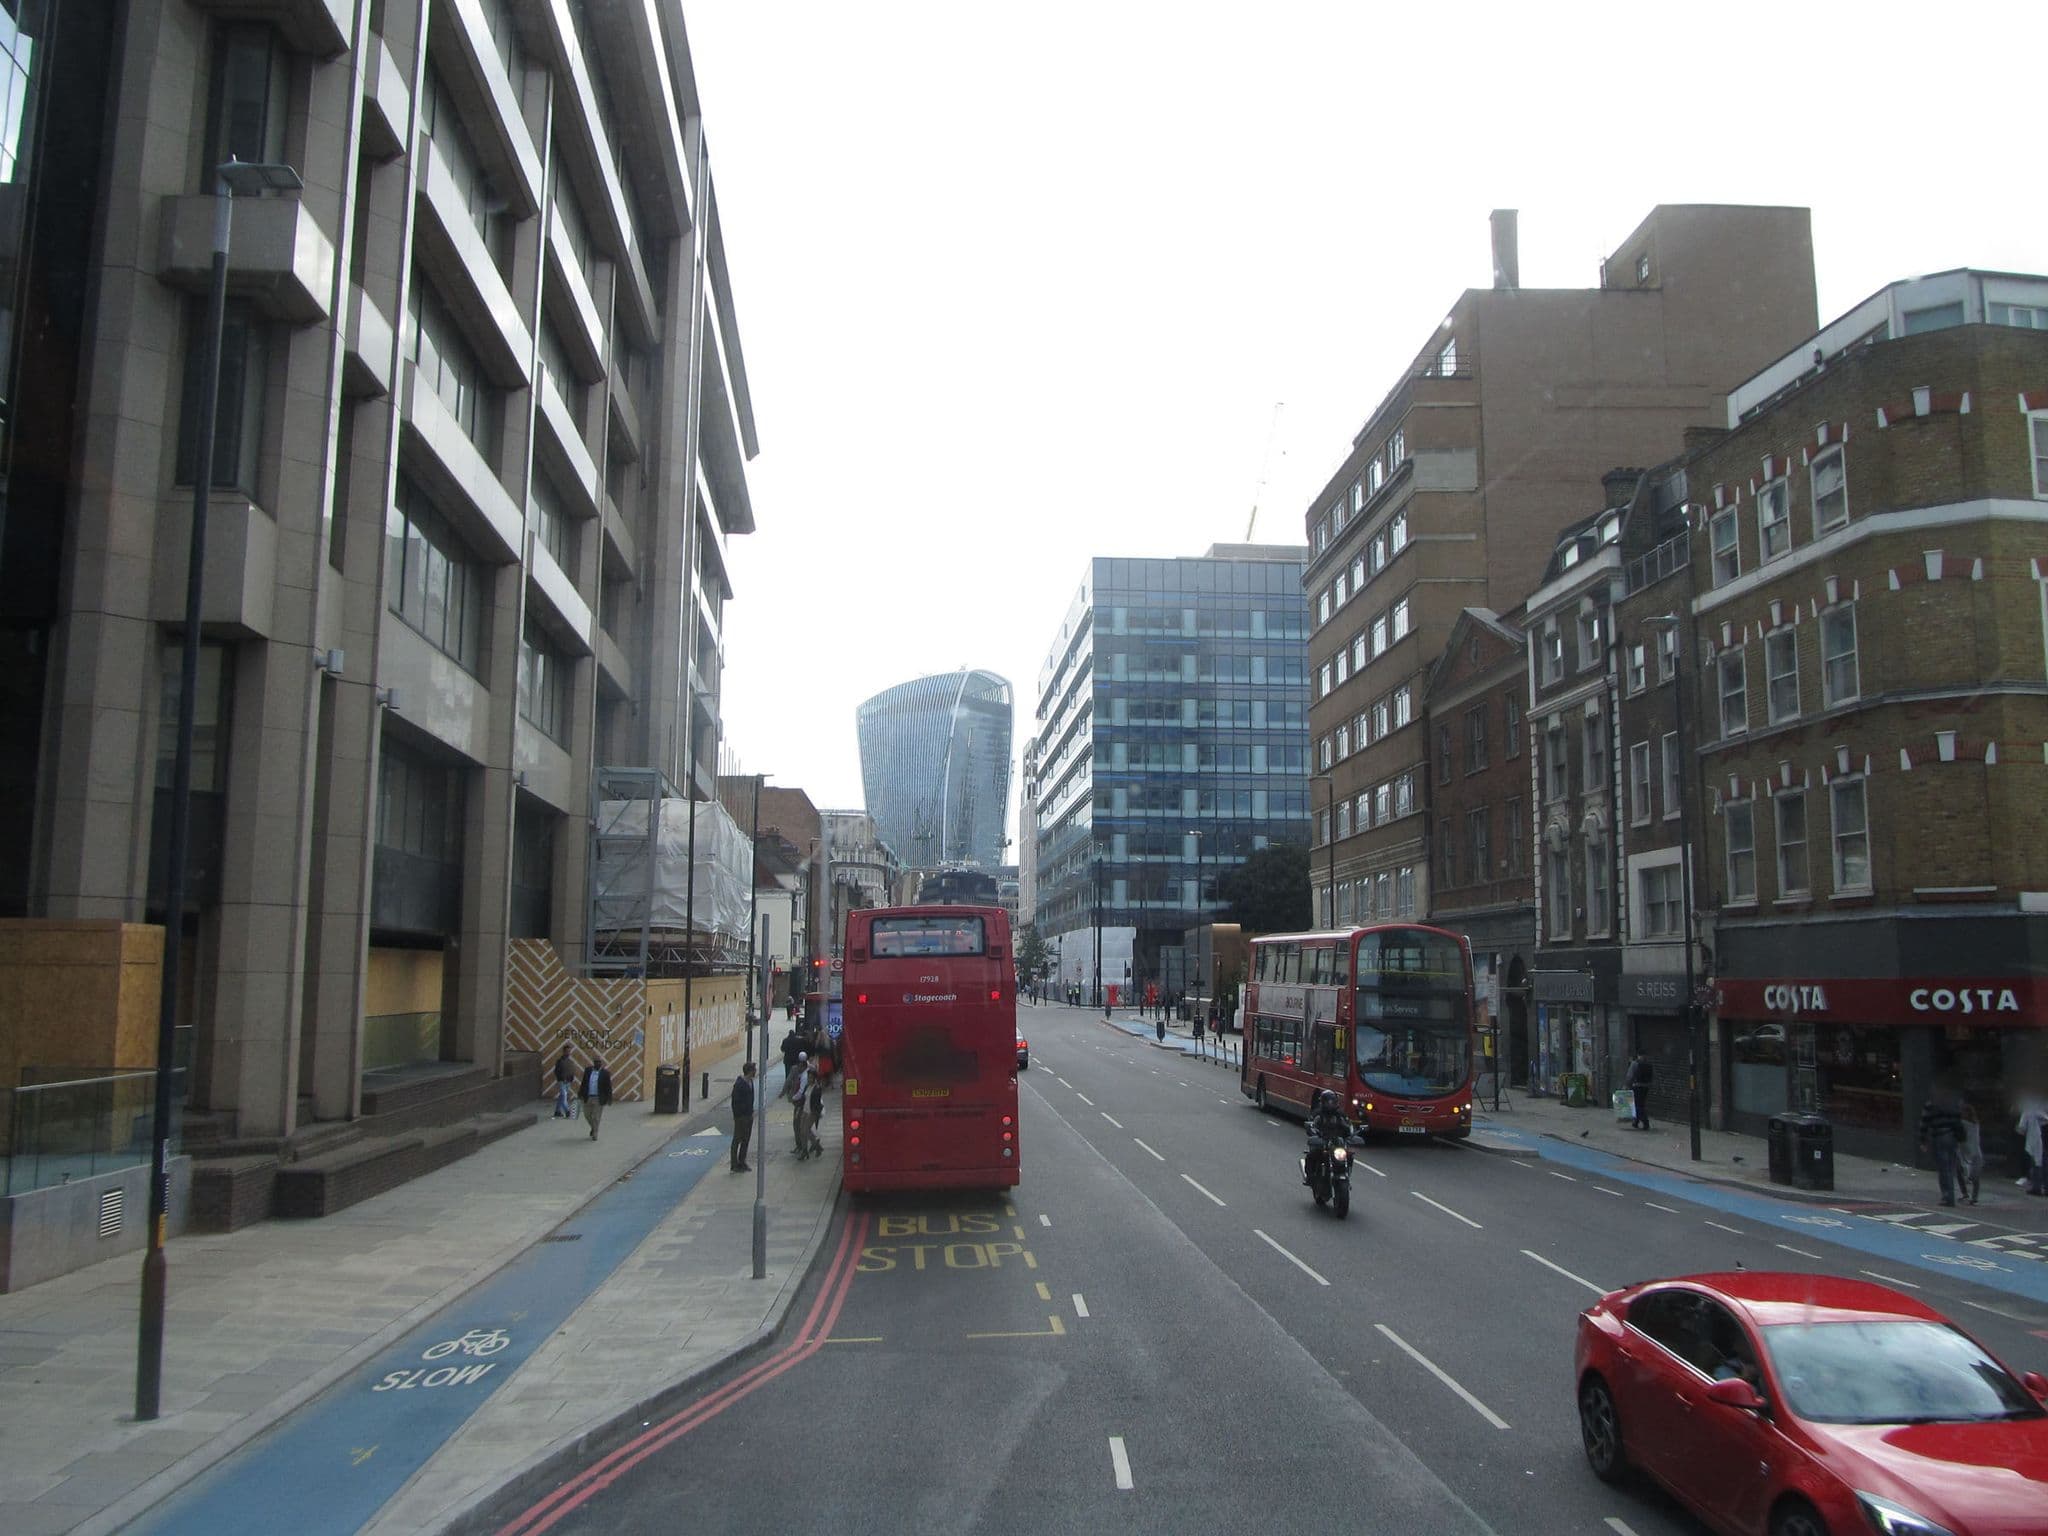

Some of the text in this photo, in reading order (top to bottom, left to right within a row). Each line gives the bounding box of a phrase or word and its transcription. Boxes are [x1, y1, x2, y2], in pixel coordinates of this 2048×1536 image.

[914, 993, 957, 1003] Stagecoach
[1764, 985, 1828, 1014] COSTA
[1910, 988, 2019, 1014] COSTA
[556, 1029, 611, 1039] DERWENT
[580, 1040, 632, 1050] LONDON
[878, 1213, 1000, 1237] BUS
[856, 1242, 1023, 1272] STOP
[372, 1363, 497, 1392] SLOW
